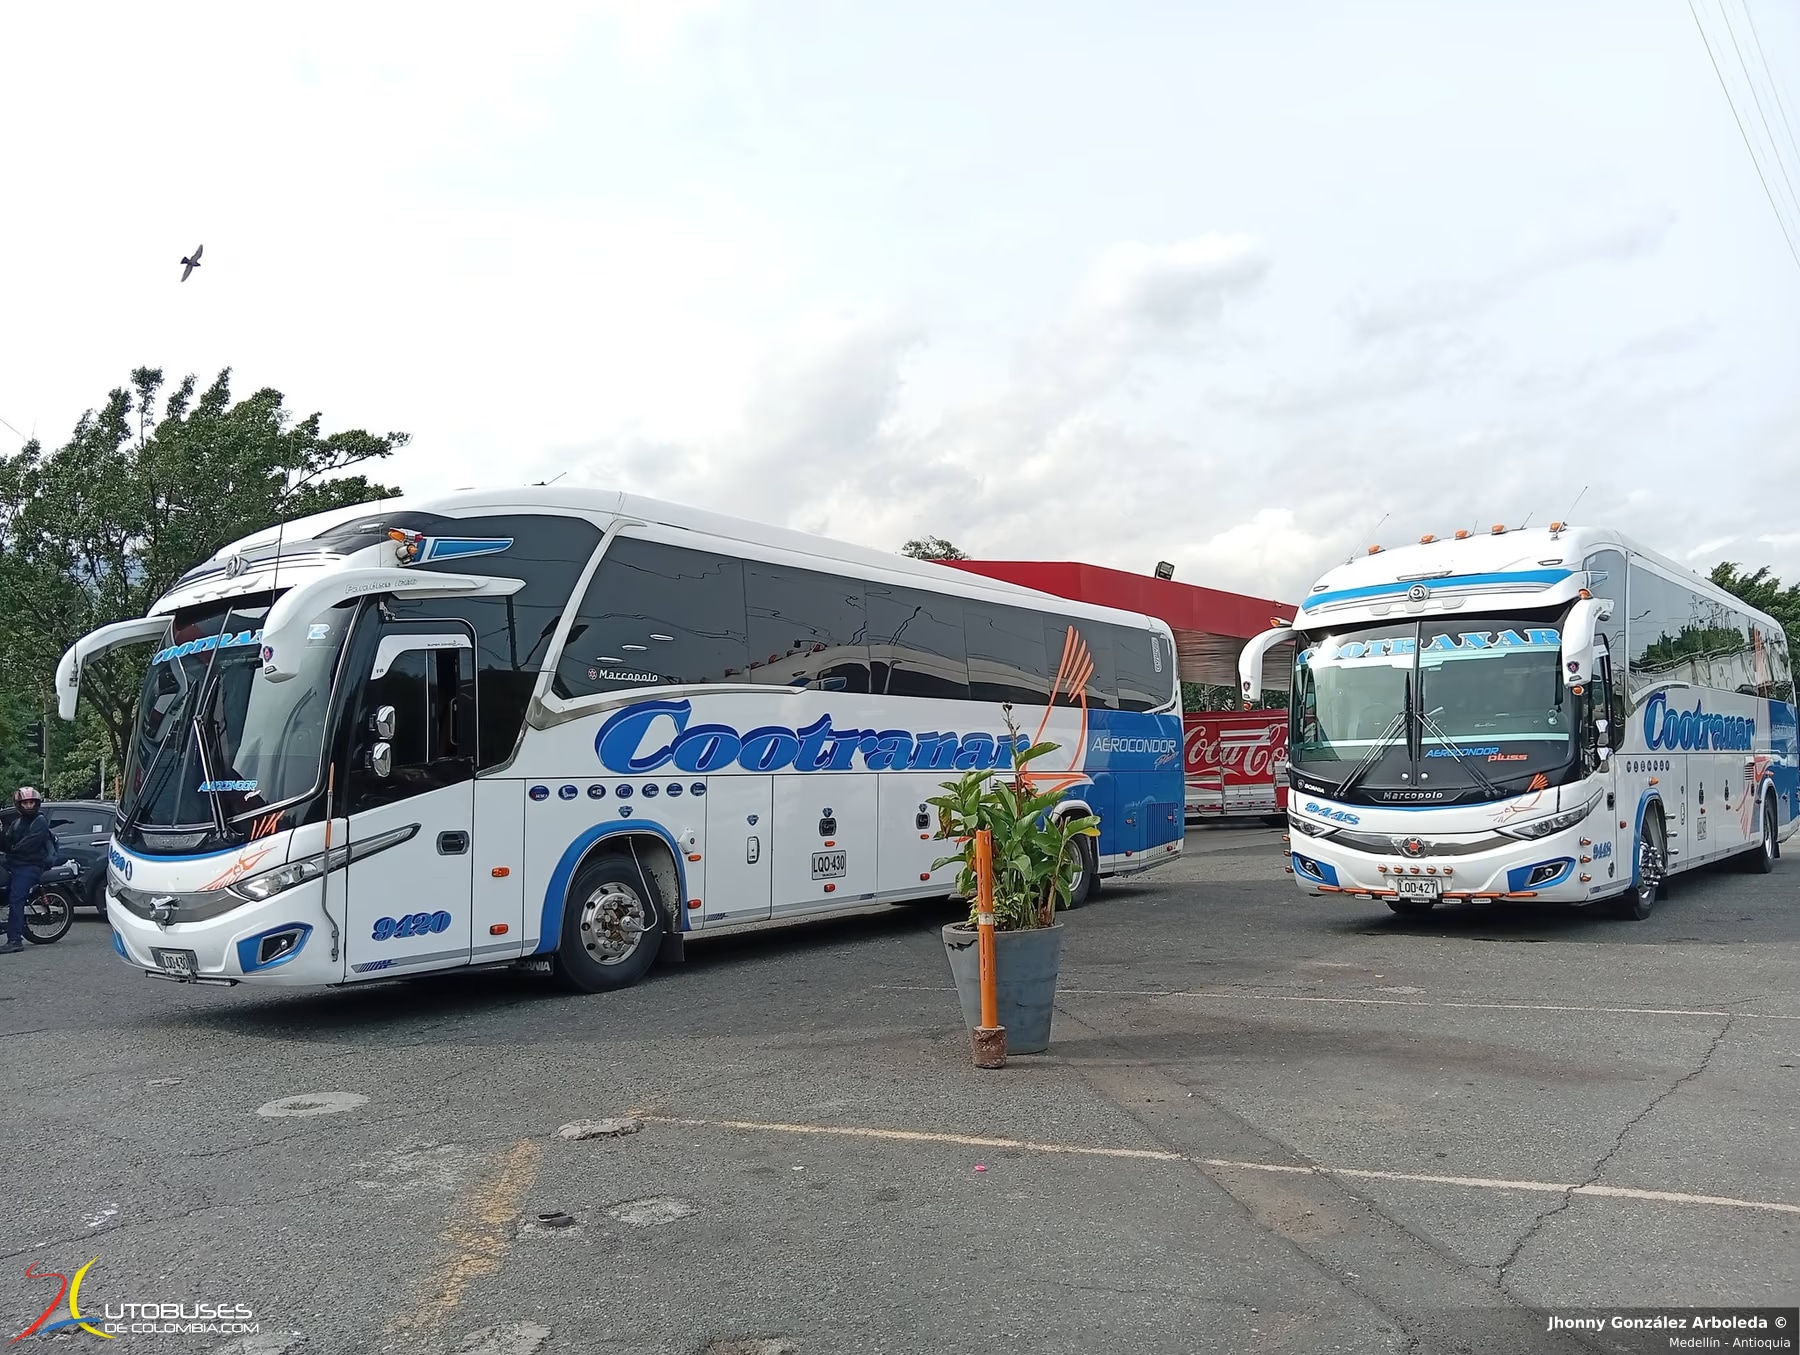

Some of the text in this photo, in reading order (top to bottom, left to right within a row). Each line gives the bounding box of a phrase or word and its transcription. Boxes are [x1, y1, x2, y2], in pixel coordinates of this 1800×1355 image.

[599, 669, 658, 682] Marcopolo
[1643, 691, 1755, 751] Cootranar
[594, 699, 1031, 774] Cootranar
[1091, 736, 1176, 753] AEROCONDOR
[1425, 747, 1499, 757] AEROCONDOR
[1487, 753, 1528, 762] pluss
[1304, 783, 1325, 794] SCANIA
[1383, 791, 1443, 800] Marcopolo
[371, 910, 452, 941] 9420
